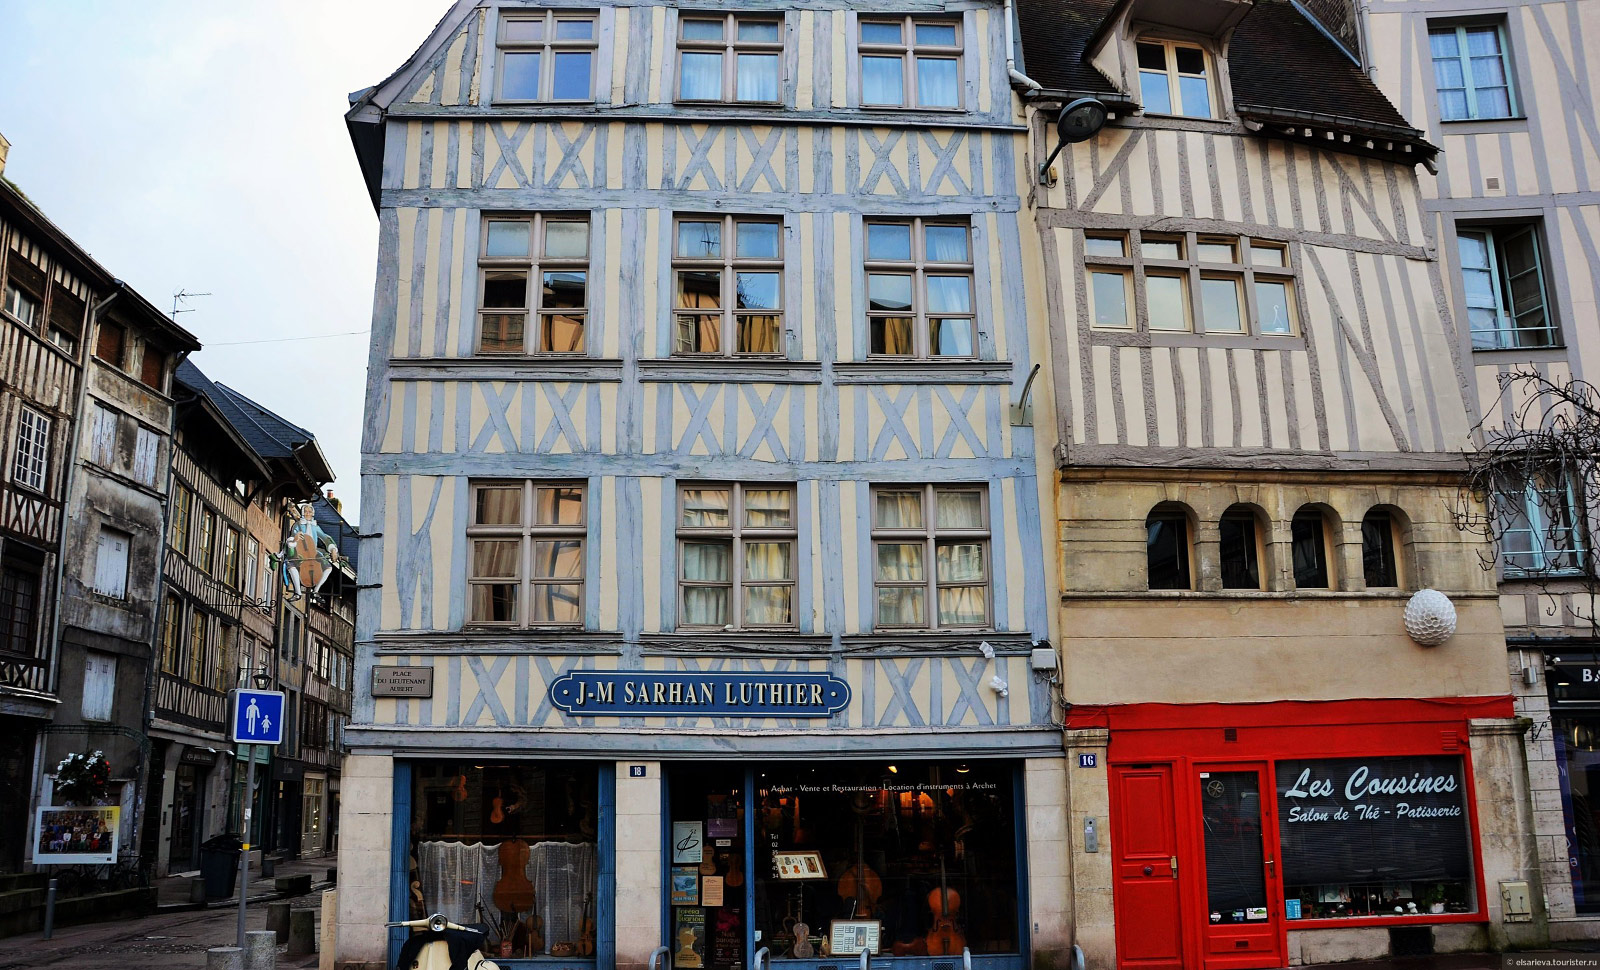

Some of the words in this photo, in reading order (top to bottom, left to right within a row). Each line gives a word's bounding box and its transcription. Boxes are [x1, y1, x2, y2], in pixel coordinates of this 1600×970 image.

[576, 681, 614, 705] J-M
[624, 682, 714, 704] SARHAN
[724, 683, 824, 705] LUTHIER
[1082, 755, 1094, 766] 16
[634, 766, 642, 776] 18
[770, 784, 793, 792] Achat
[800, 784, 821, 792] Vente
[832, 784, 877, 792] Restauration
[883, 783, 915, 791] Location
[916, 783, 964, 791] d'instruments
[972, 781, 997, 789] Archet
[1284, 767, 1335, 798] Les
[1344, 765, 1458, 801] Cousines
[1287, 806, 1329, 823] Salon
[1333, 807, 1349, 821] de
[1354, 805, 1380, 820] Thé
[1396, 802, 1462, 819] Patisserie
